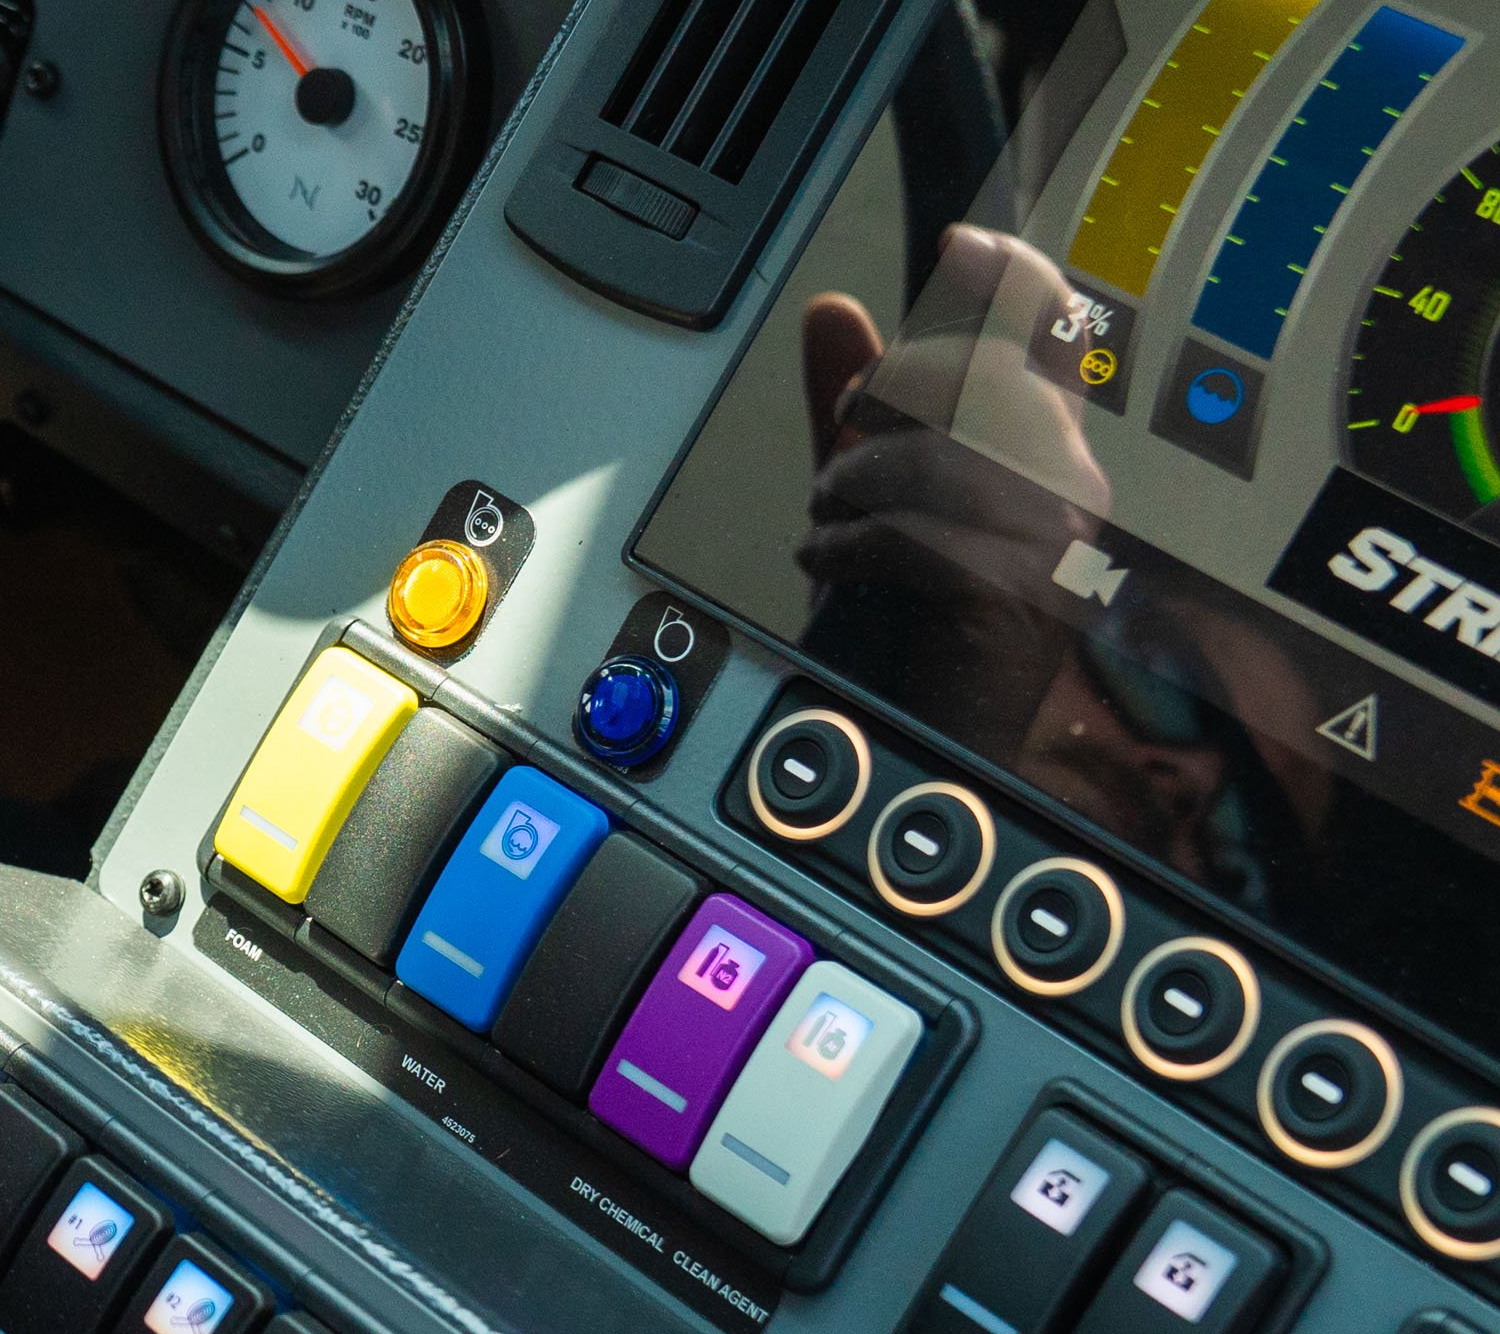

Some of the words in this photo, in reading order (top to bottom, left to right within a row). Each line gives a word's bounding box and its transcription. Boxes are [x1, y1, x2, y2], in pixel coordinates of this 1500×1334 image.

[343, 3, 376, 29] RPM
[249, 51, 266, 71] 5
[399, 37, 425, 65] 20
[250, 133, 266, 153] 0
[354, 180, 382, 207] 30
[1051, 292, 1115, 343] 3%
[1408, 284, 1453, 323] 40
[224, 928, 264, 962] FOAM
[401, 1054, 447, 1094] WATER
[441, 1115, 477, 1145] 4523075
[67, 1214, 84, 1230] #1
[569, 1176, 600, 1203] DRY
[598, 1196, 667, 1254] CHEMICAL
[672, 1249, 723, 1291] CLEAN
[716, 1283, 770, 1325] AGENT
[165, 1291, 183, 1310] #2
